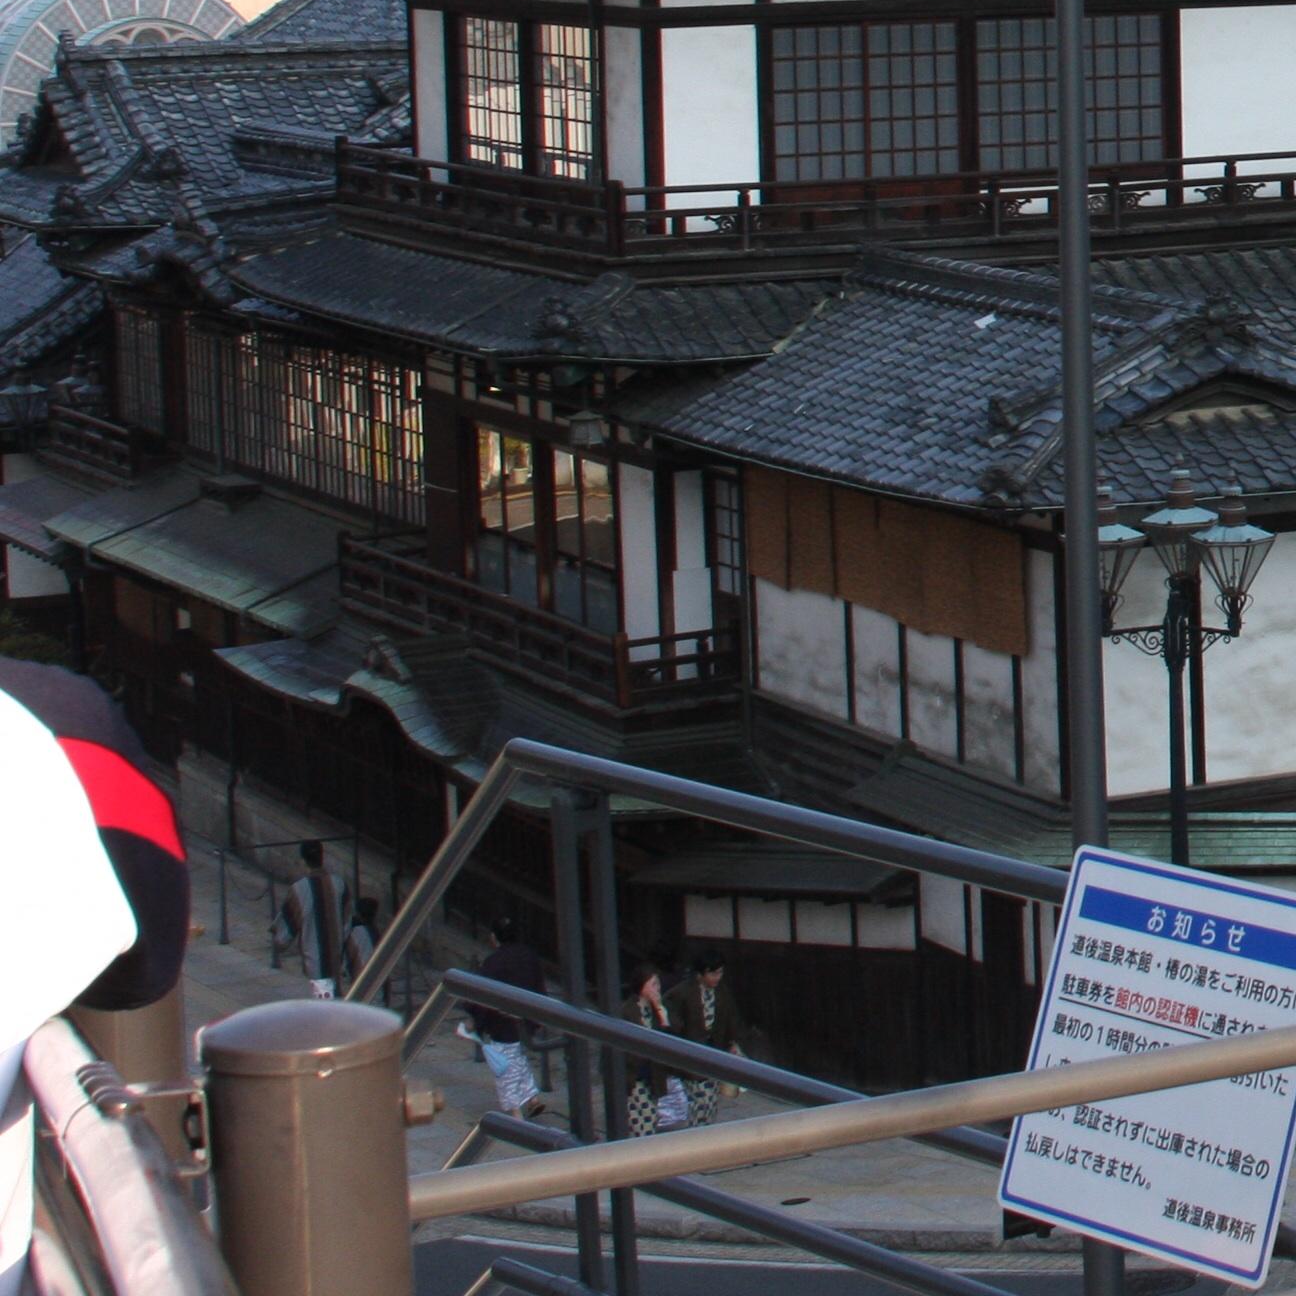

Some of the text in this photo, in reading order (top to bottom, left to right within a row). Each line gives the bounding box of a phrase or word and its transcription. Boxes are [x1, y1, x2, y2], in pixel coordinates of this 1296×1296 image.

[1146, 905, 1248, 954] お知らせ
[1059, 972, 1268, 1036] 駐車券を館内の認証機に通され
[1024, 1130, 1153, 1191] 払戻しはできません。
[1161, 1196, 1257, 1245] 道後温泉事務所
